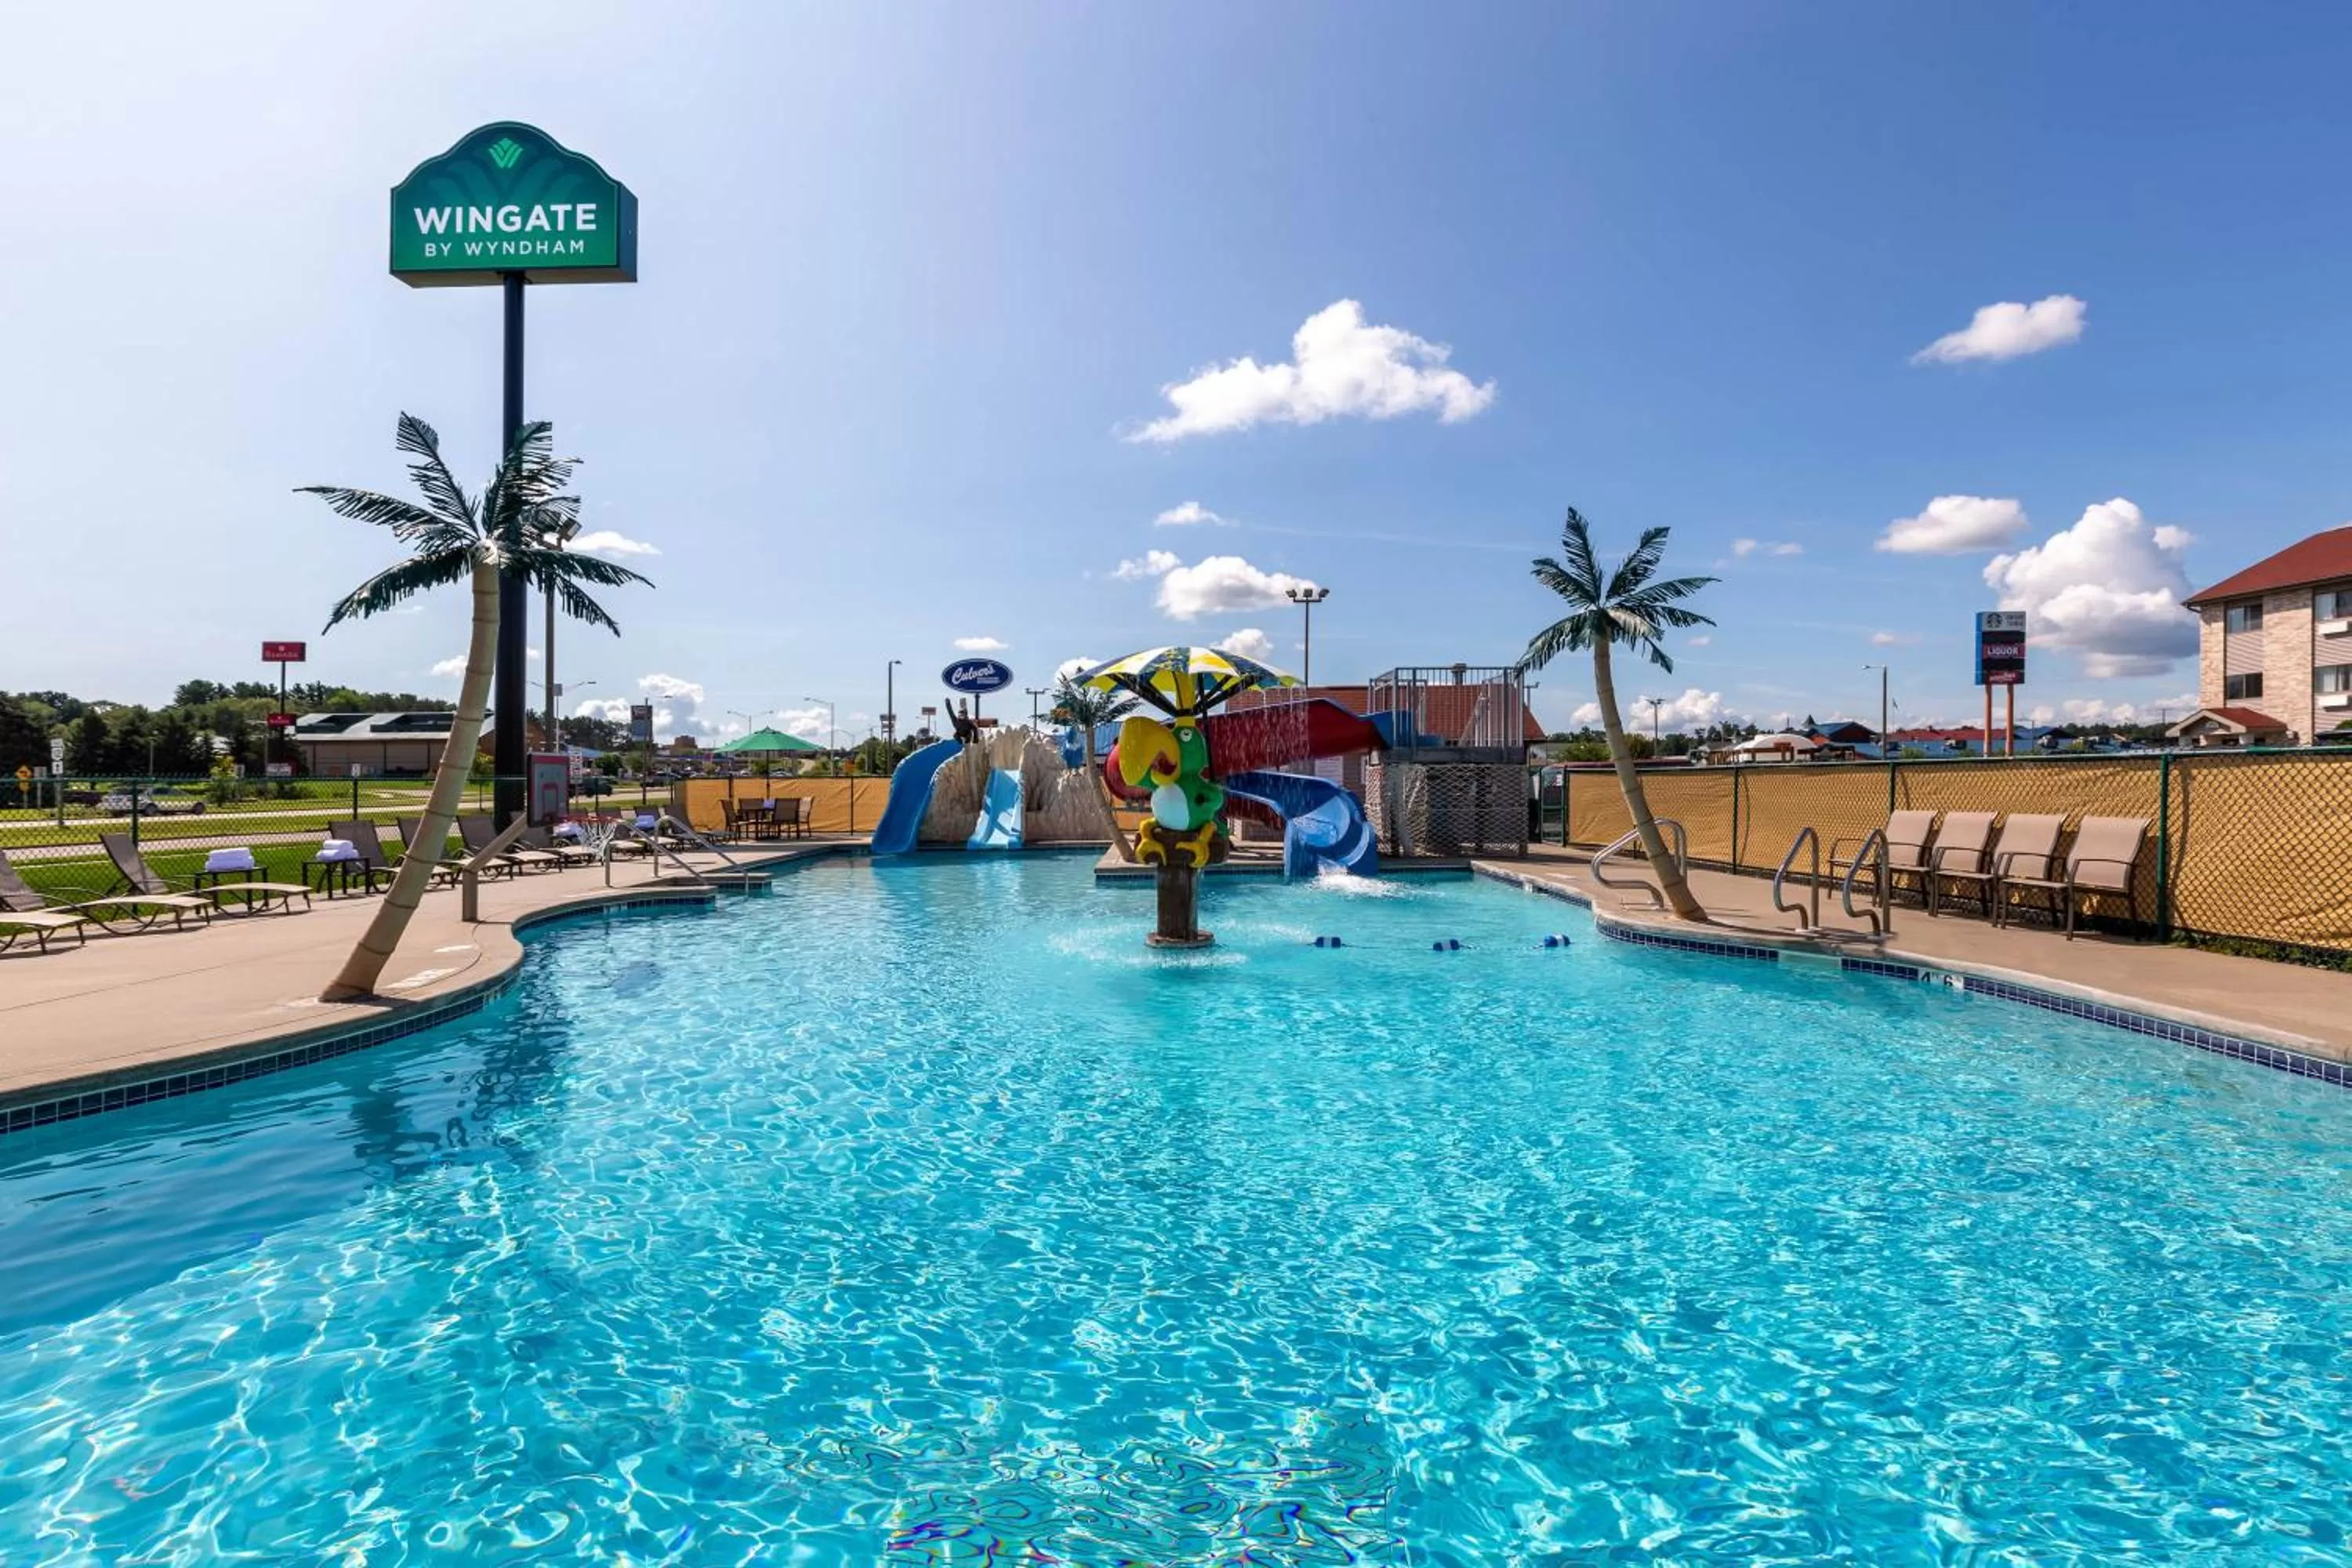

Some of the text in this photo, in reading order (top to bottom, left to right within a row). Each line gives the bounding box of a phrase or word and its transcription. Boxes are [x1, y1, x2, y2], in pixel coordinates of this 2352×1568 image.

[413, 202, 597, 235] WINGATE
[424, 239, 585, 257] BY WYNDHAM
[1987, 645, 2020, 655] LIQUOR
